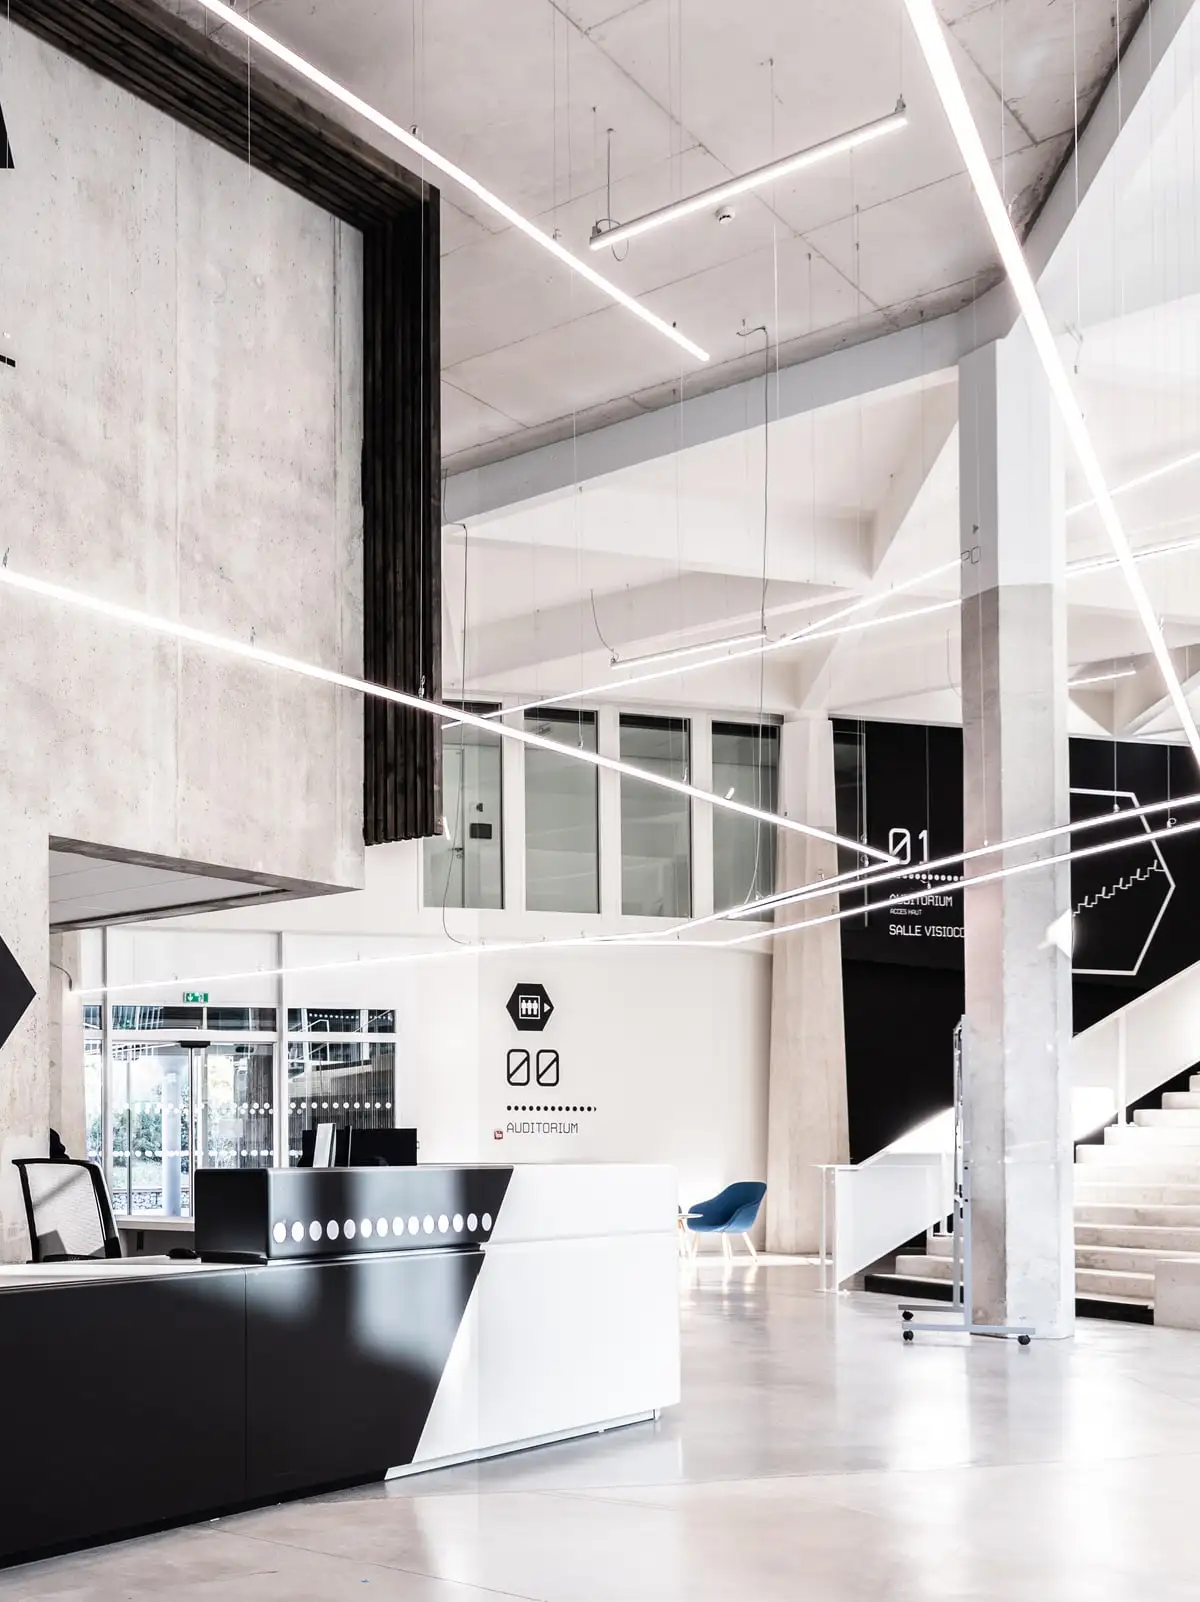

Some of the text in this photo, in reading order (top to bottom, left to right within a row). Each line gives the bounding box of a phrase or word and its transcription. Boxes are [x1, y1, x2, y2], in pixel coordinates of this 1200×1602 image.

[888, 828, 928, 865] 01
[889, 924, 922, 937] SALLE
[506, 1048, 560, 1087] 00
[506, 1121, 579, 1134] AUDITORIUM
